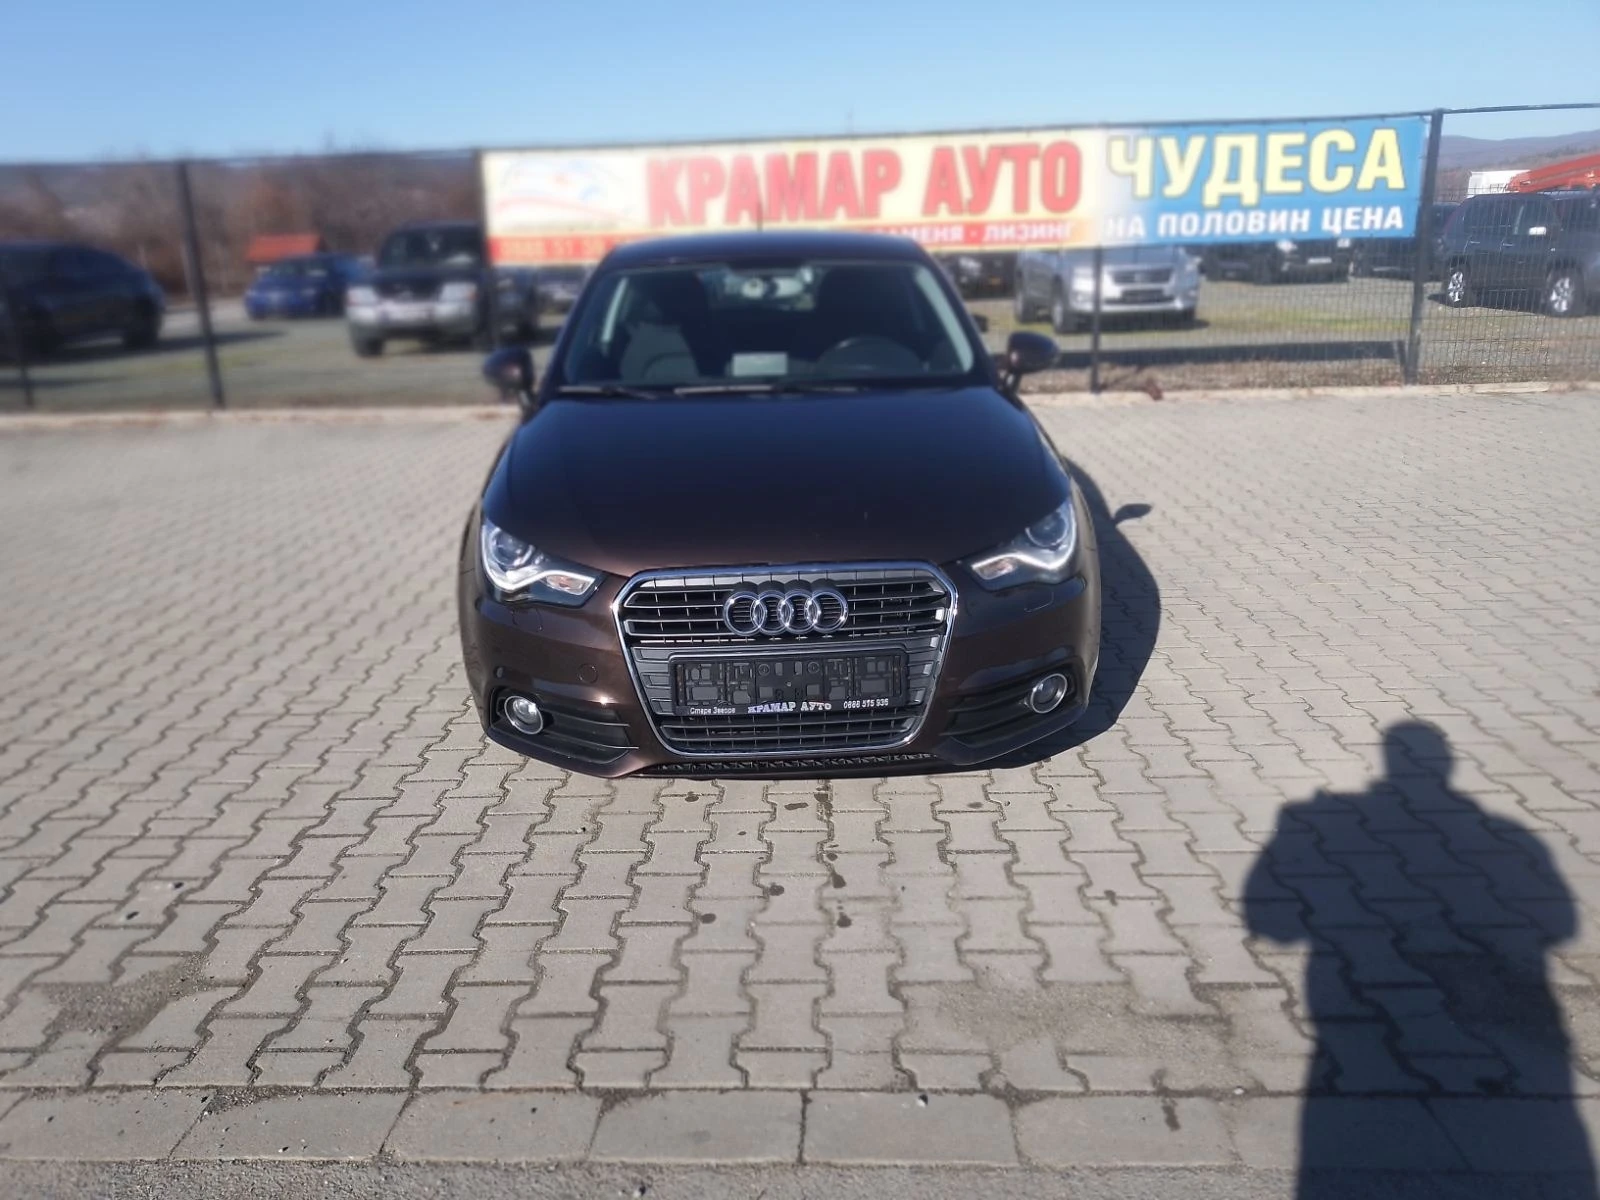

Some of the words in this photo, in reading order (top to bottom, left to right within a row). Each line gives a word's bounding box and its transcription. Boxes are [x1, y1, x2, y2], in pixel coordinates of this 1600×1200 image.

[646, 149, 903, 227] КРАМАР
[921, 141, 1082, 217] АУТО
[1107, 129, 1405, 208] ЧУДЕСА
[1105, 216, 1146, 240] НА
[1157, 210, 1308, 238] ПОЛОВИН
[1321, 206, 1404, 237] ЦЕНА
[747, 701, 796, 714] КРАМАР
[800, 701, 832, 712] АУТО
